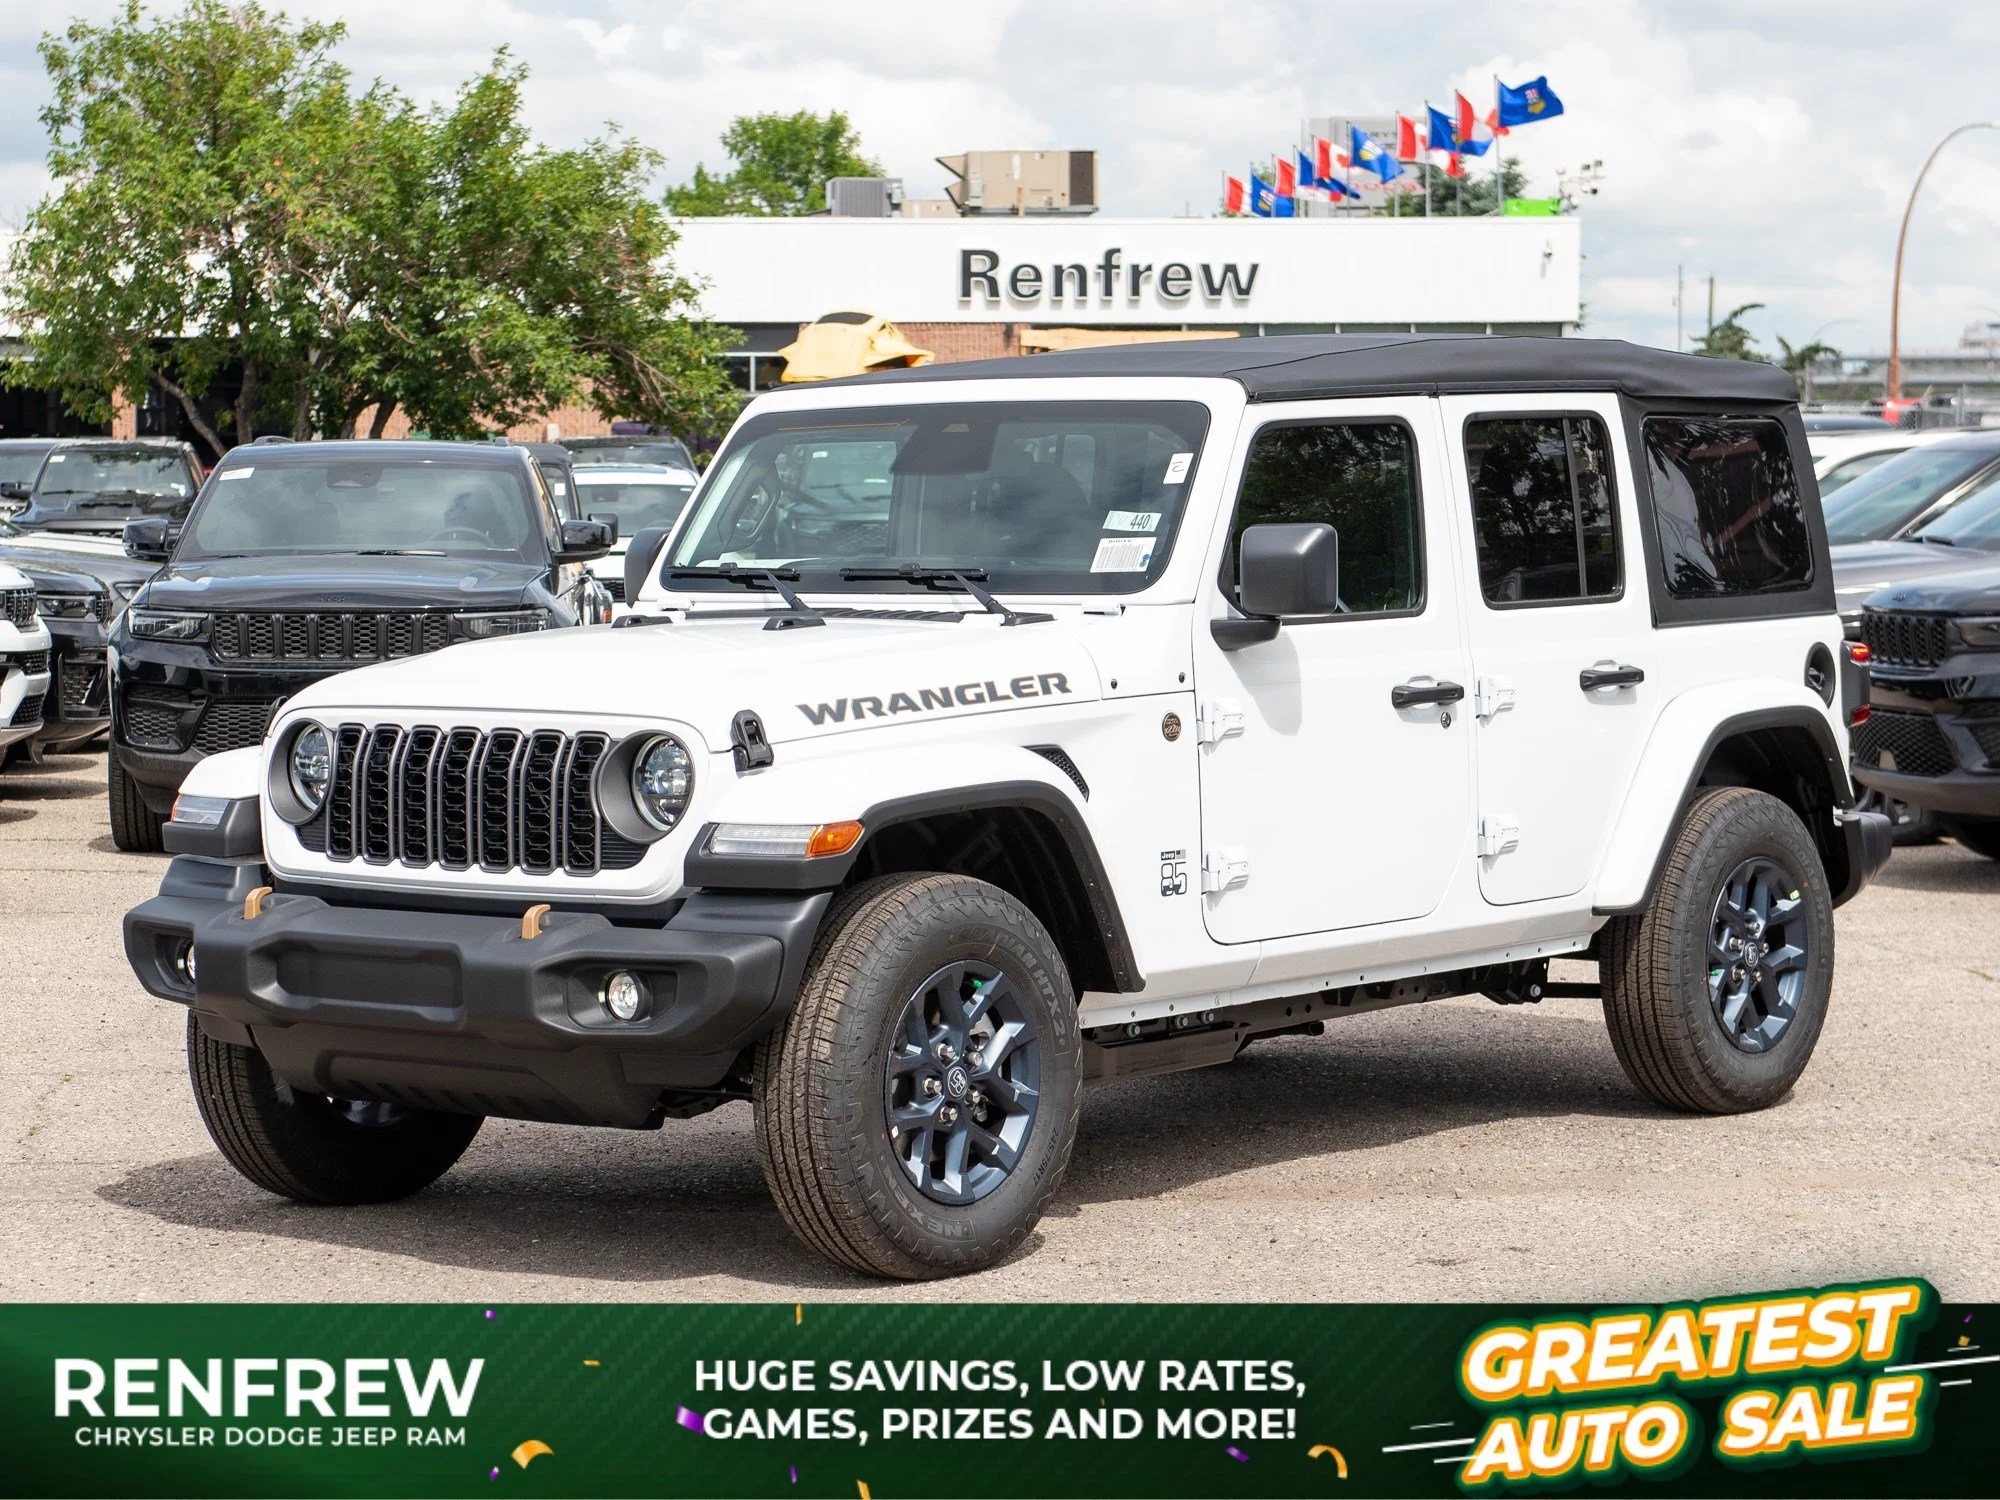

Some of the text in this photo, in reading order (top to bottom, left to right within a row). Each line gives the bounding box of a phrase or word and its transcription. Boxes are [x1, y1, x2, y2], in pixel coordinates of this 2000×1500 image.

[960, 247, 1260, 300] Renfrew
[1130, 514, 1151, 530] 440
[797, 672, 1073, 726] WRANGLER
[1161, 852, 1175, 860] Jeep
[1161, 862, 1187, 897] 85
